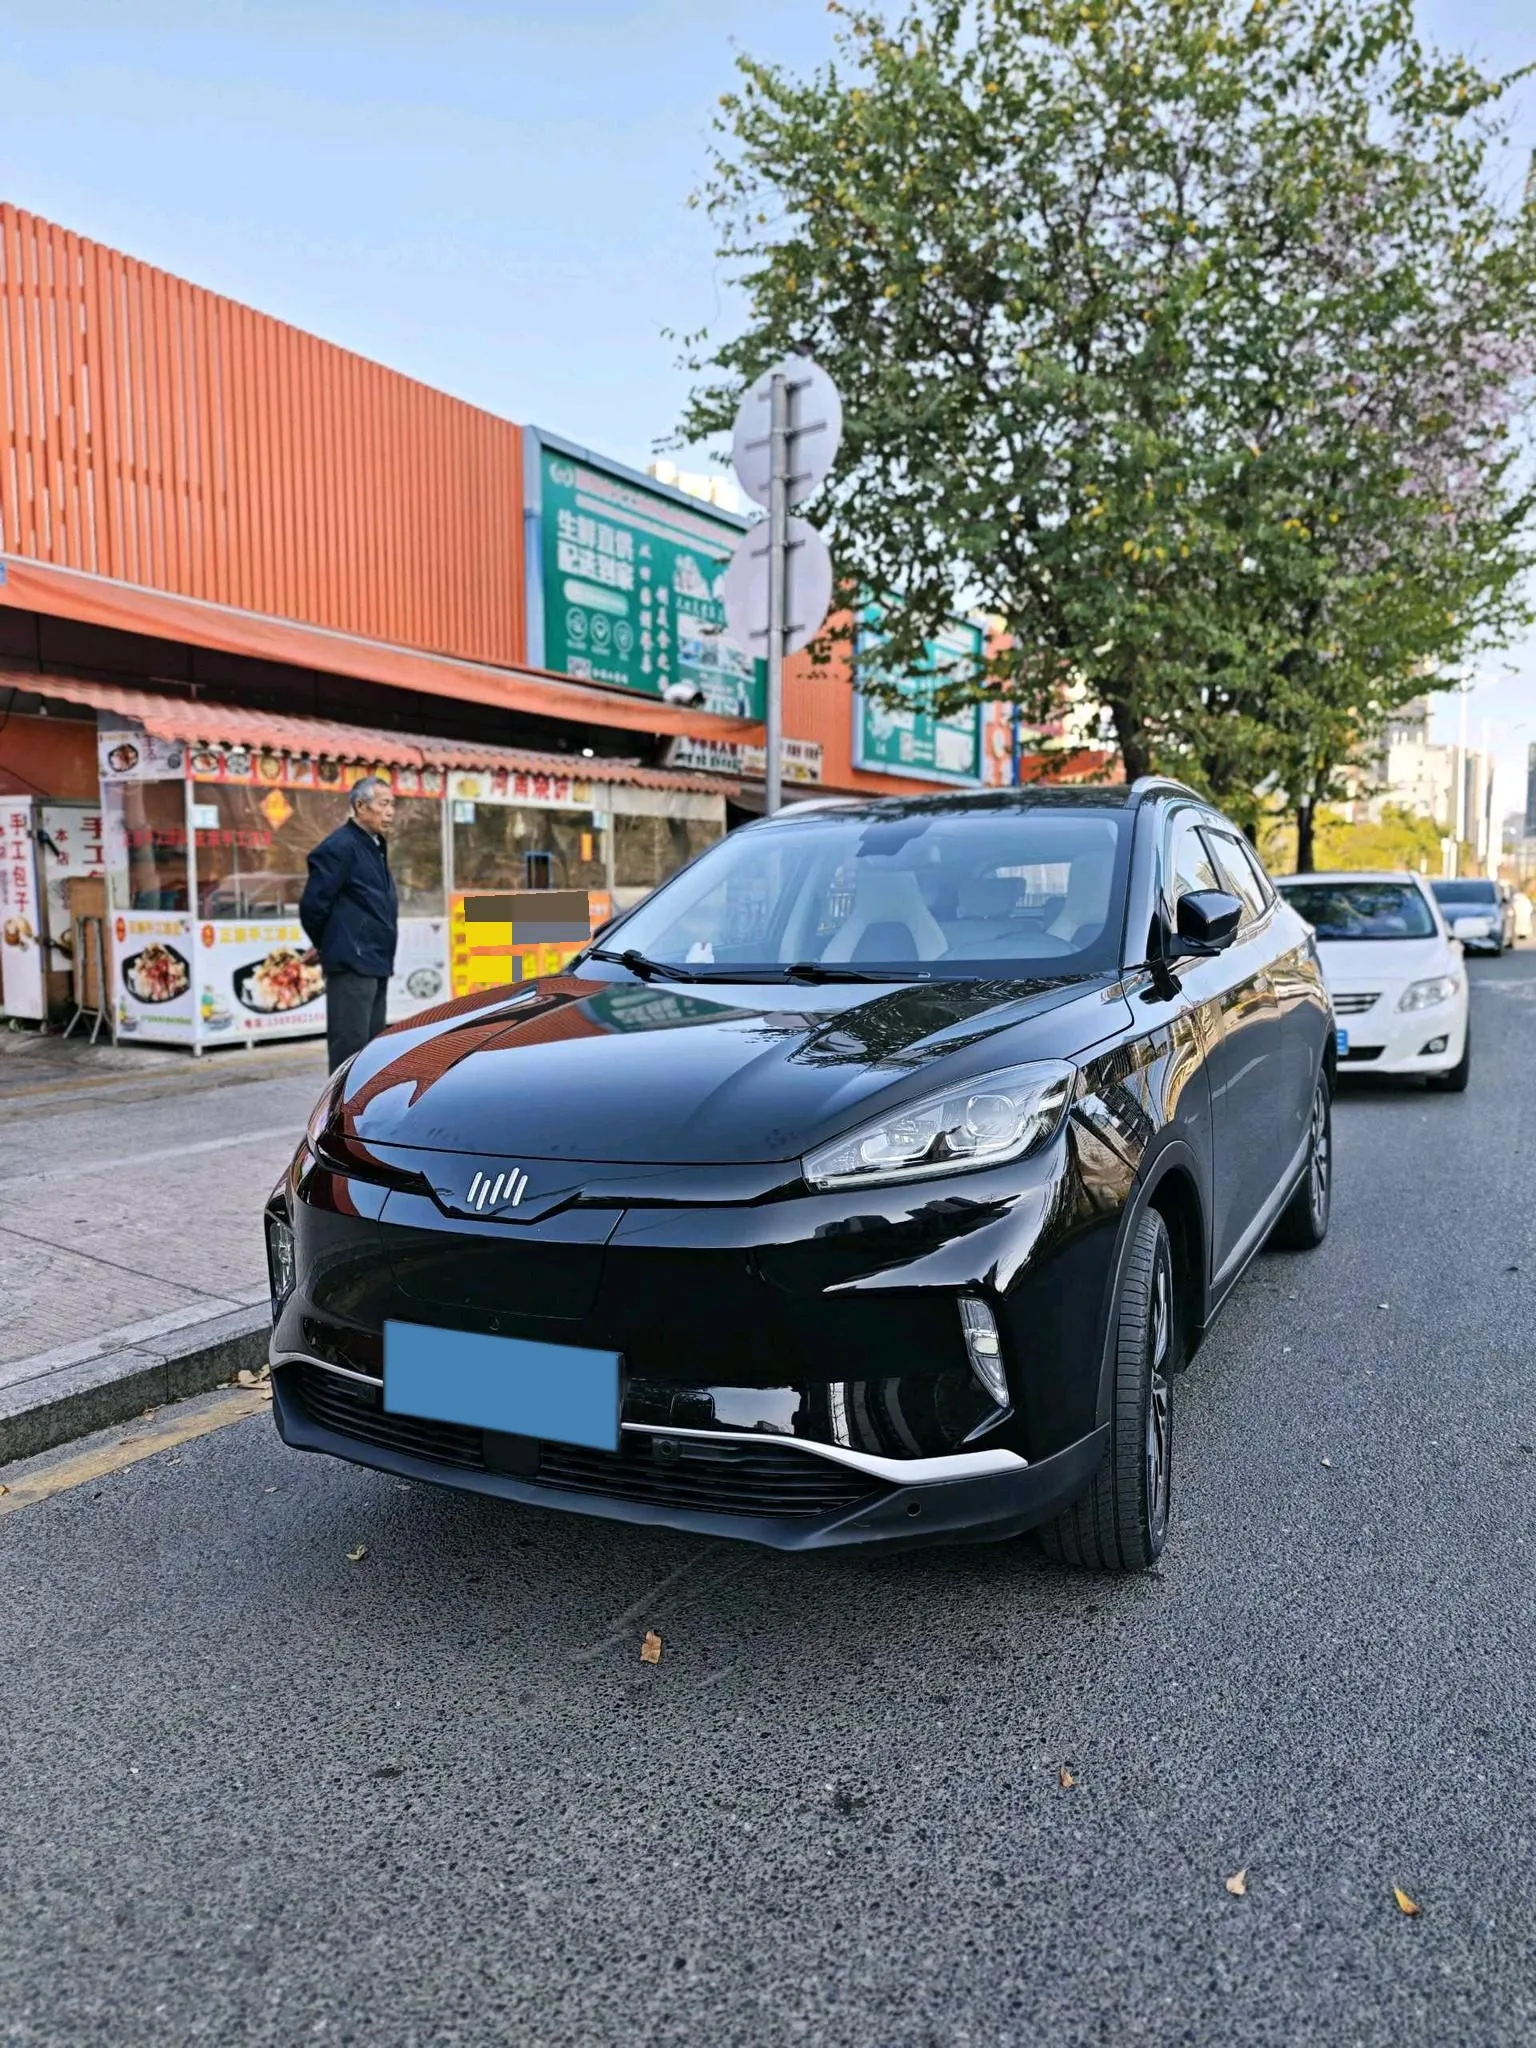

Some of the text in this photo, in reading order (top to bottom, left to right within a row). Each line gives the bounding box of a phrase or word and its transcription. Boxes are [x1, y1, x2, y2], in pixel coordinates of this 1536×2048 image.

[9, 813, 29, 912] 手工包子
[55, 828, 70, 866] 本店
[81, 817, 104, 878] 手工
